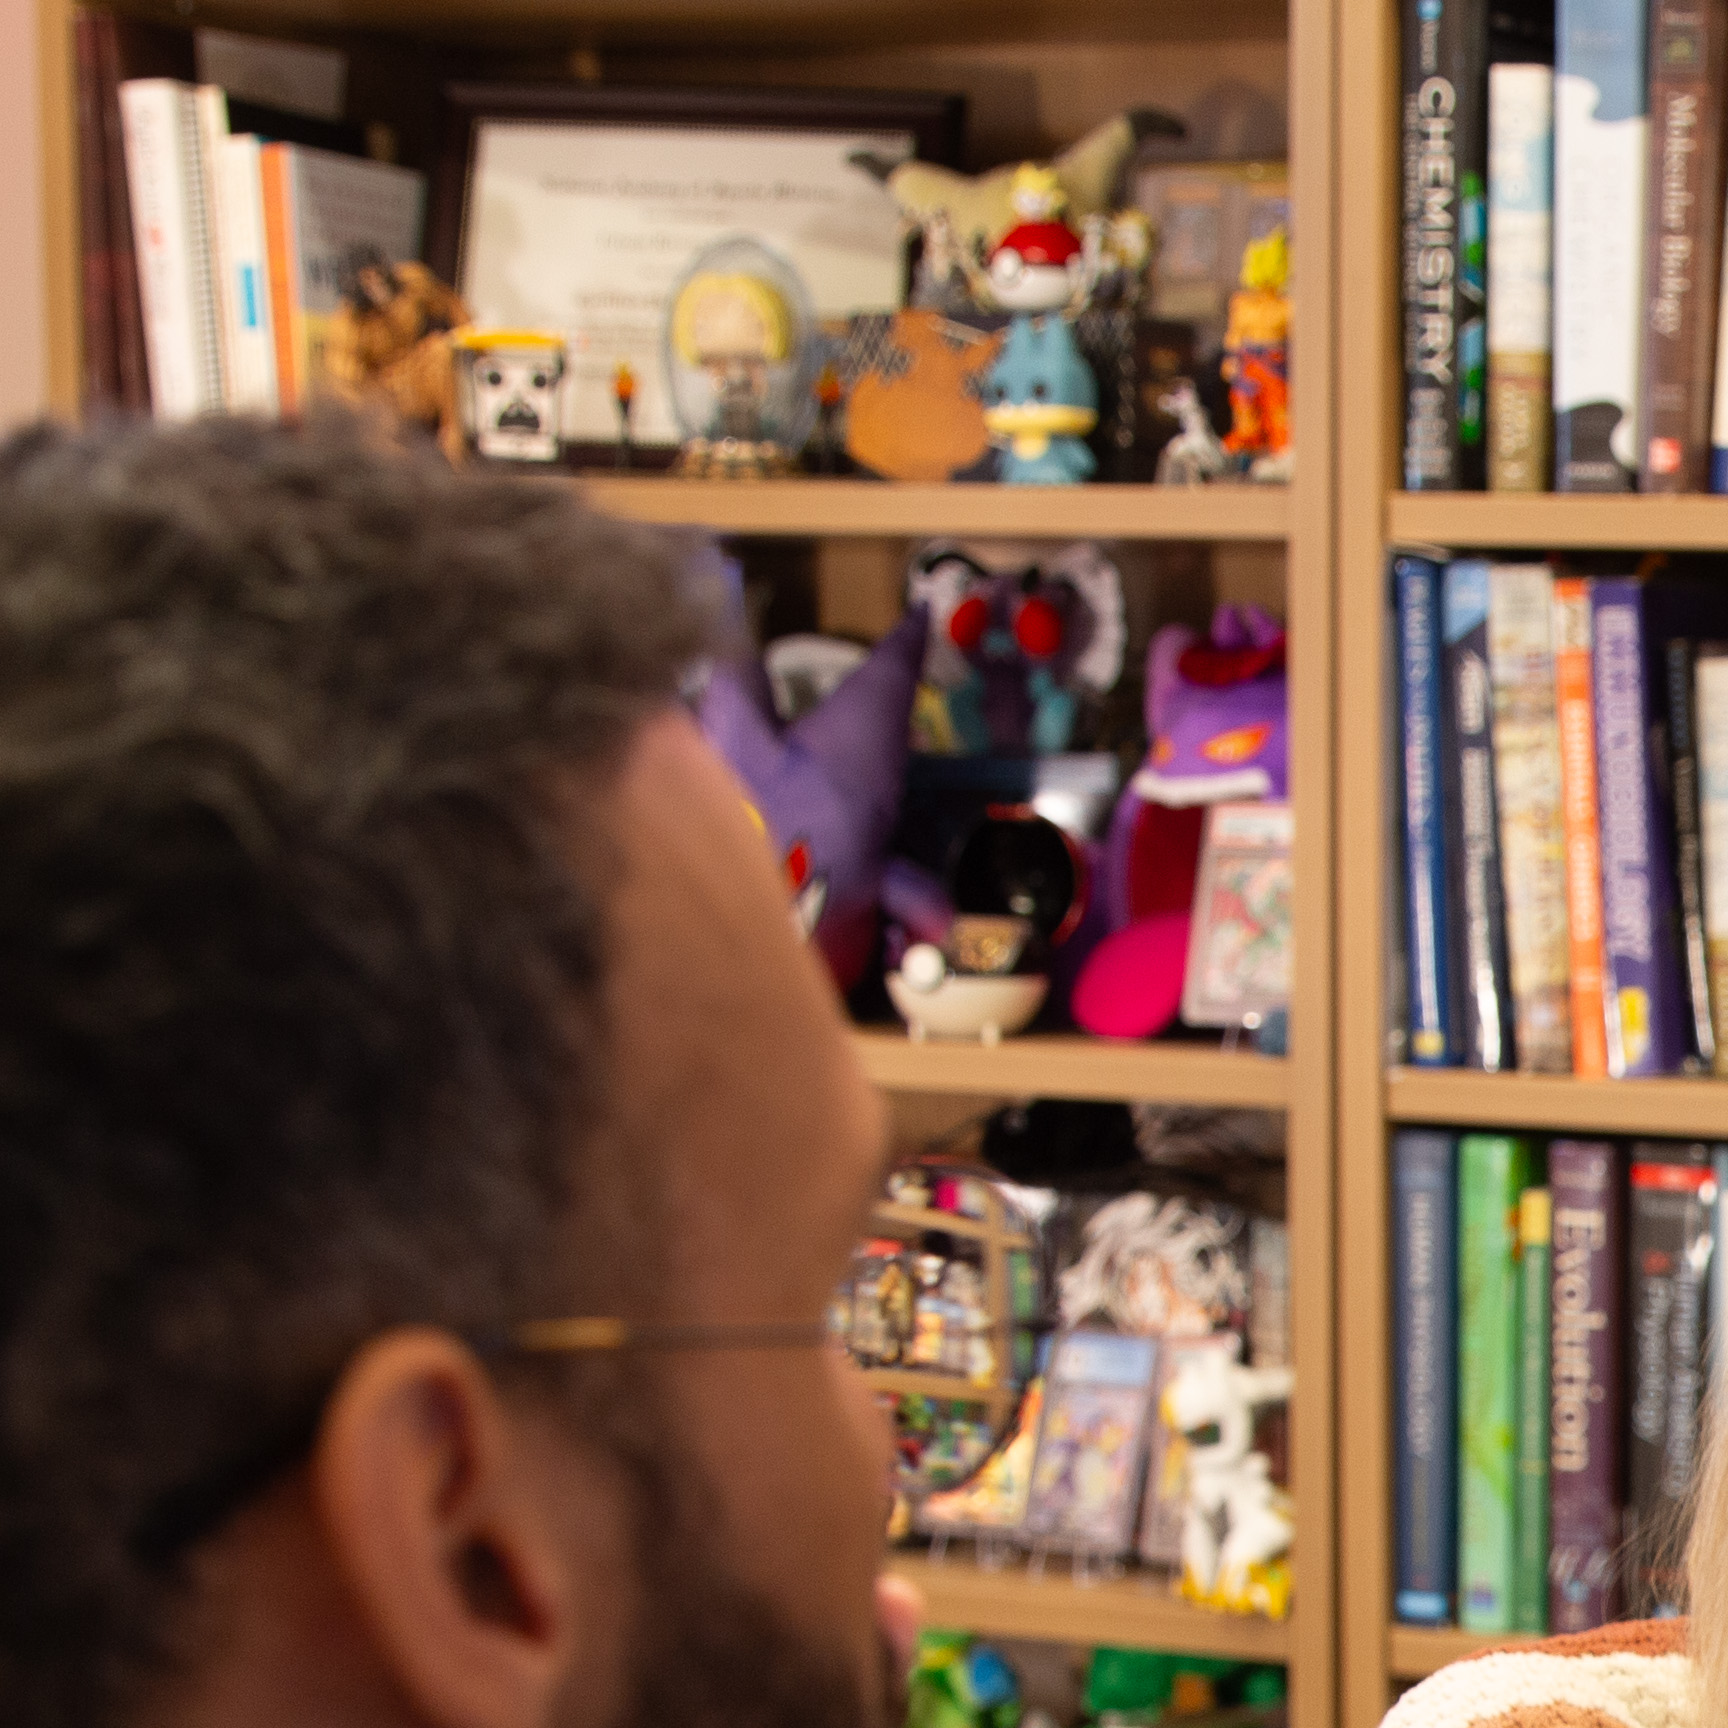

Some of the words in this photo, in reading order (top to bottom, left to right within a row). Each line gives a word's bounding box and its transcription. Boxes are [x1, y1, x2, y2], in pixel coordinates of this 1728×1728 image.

[1418, 78, 1455, 382] CHEMISTRY
[1664, 92, 1695, 230] Molecular
[1650, 235, 1690, 339] Biology
[1600, 607, 1648, 959] IMMUNOBIOLOGY
[1552, 1205, 1605, 1472] Evolution
[1635, 1281, 1670, 1443] Physiology
